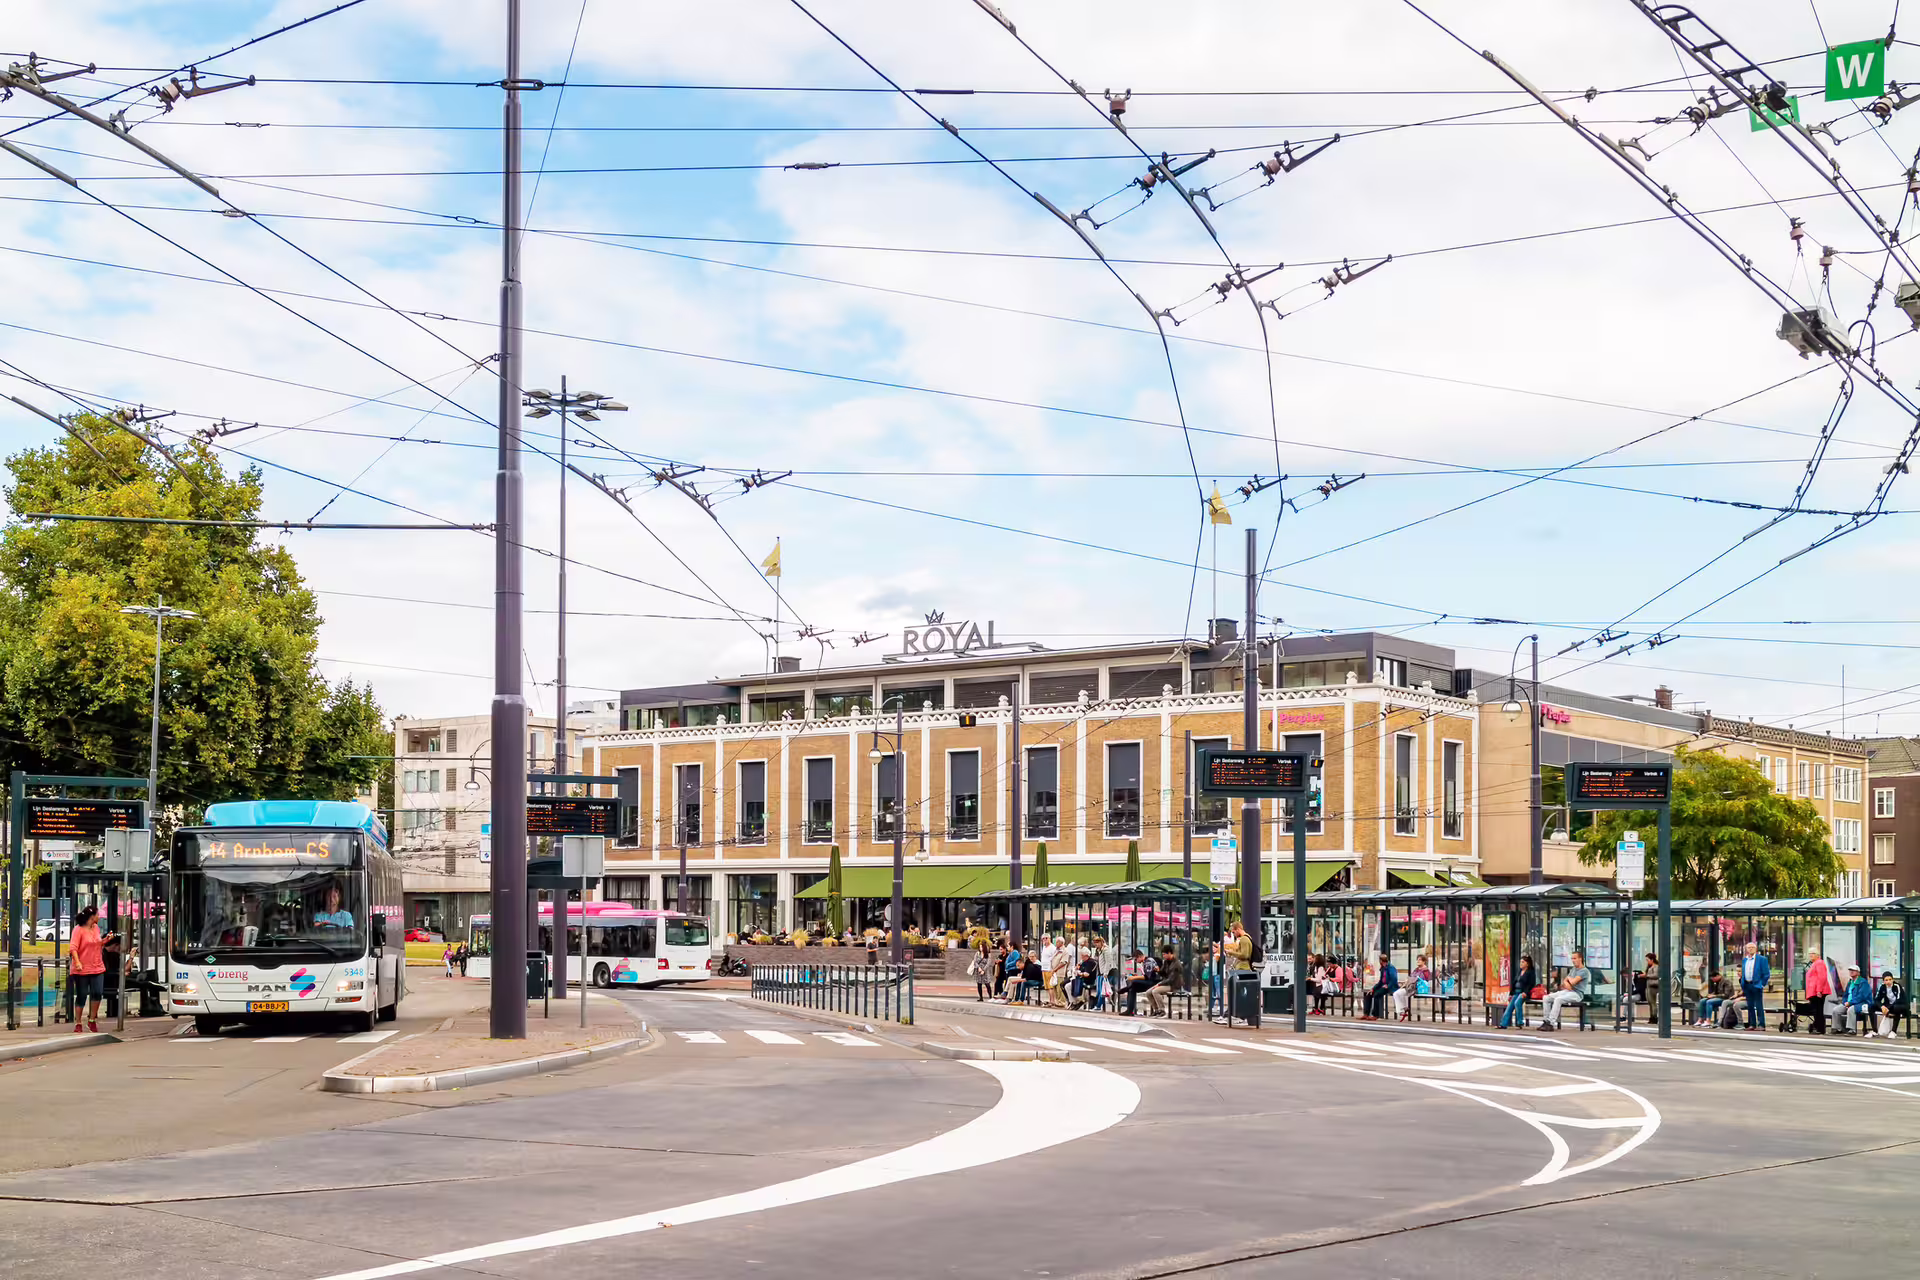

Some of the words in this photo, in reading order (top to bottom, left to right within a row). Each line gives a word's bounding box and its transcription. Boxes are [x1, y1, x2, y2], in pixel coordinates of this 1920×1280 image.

[1836, 52, 1875, 89] W
[903, 620, 1002, 655] ROYAL
[1279, 711, 1325, 725] Perplex
[209, 842, 227, 858] 14
[306, 842, 330, 858] CS
[218, 968, 249, 981] breng
[344, 967, 365, 977] 5348
[247, 984, 287, 992] MAN
[252, 1002, 287, 1010] 04-BBJ-2
